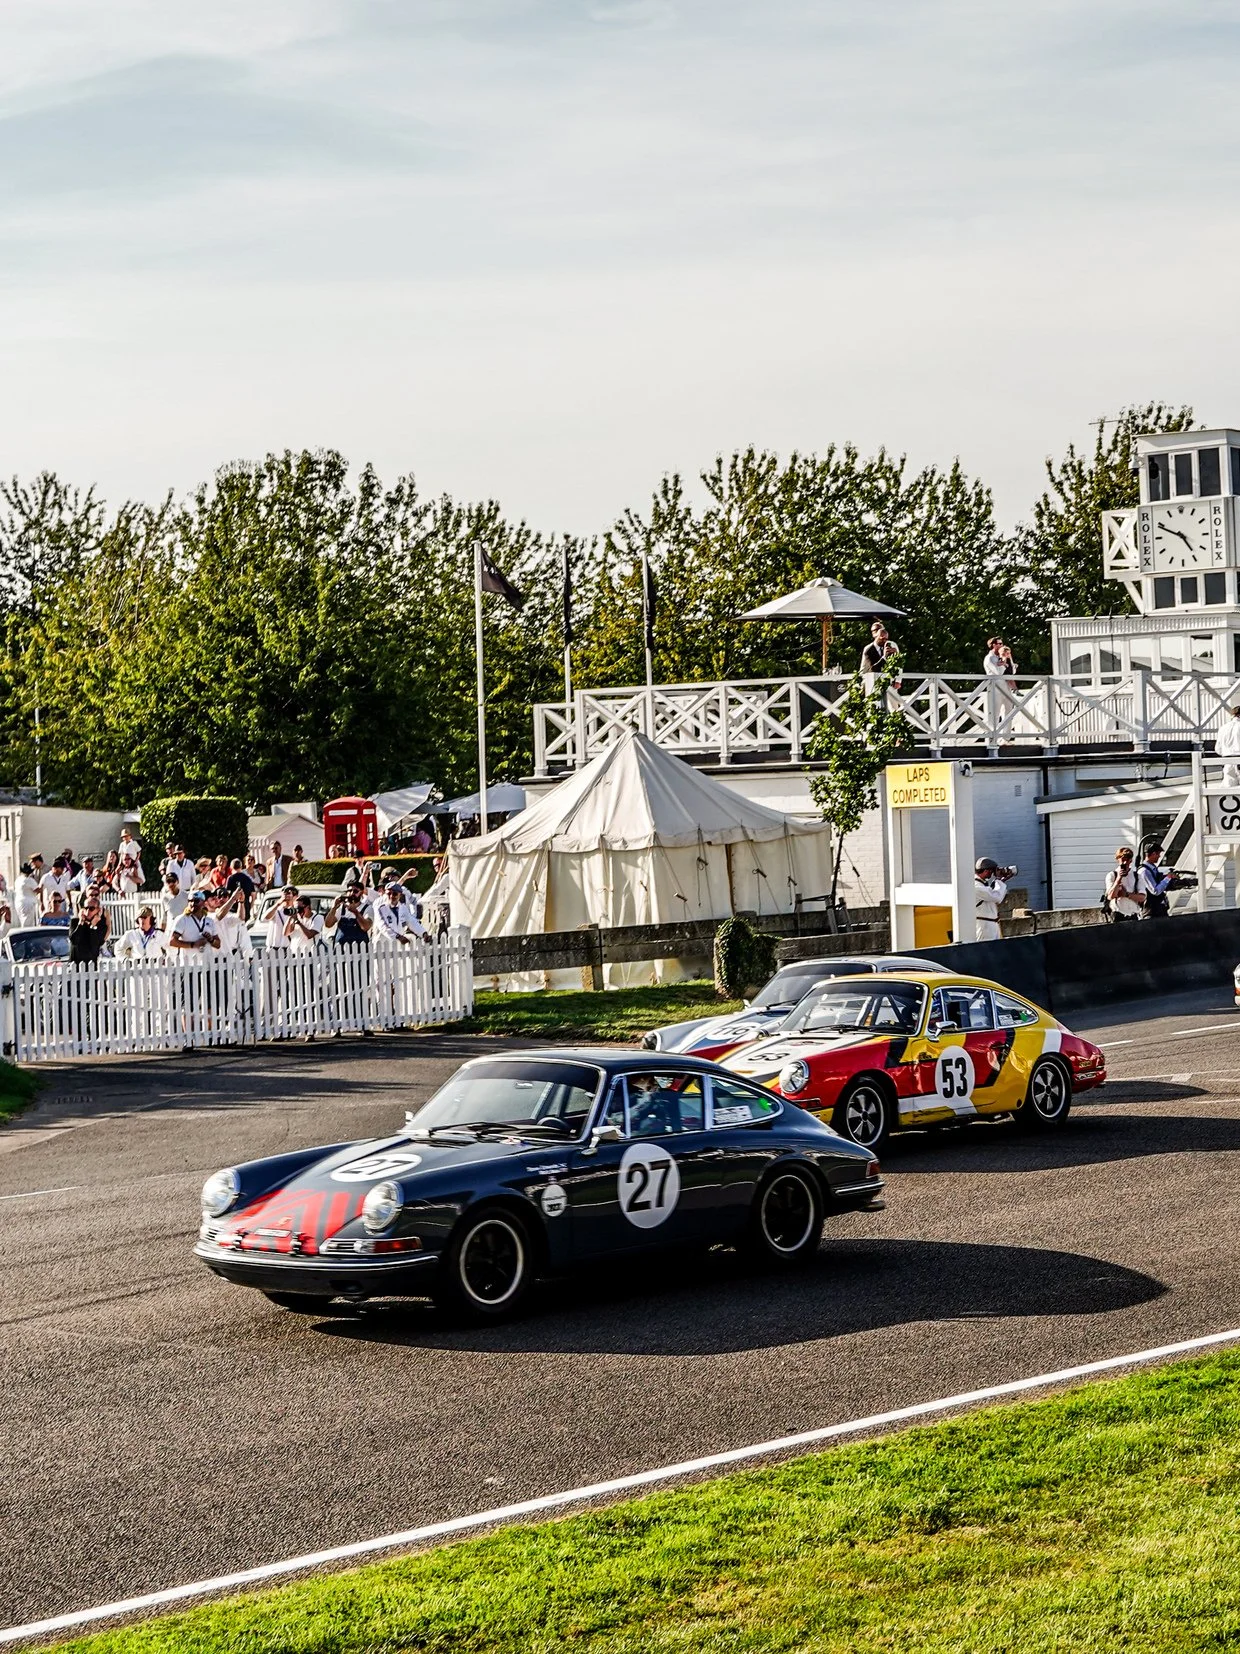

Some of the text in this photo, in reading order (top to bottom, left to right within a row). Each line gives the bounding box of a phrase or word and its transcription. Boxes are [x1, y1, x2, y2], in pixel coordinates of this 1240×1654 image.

[1141, 512, 1152, 567] ROLEX
[1213, 506, 1224, 561] ROLEX
[906, 767, 930, 782] LAPS
[892, 787, 946, 804] COMPLETED
[747, 1052, 791, 1061] 53
[941, 1057, 968, 1099] 53
[345, 1158, 414, 1176] 27
[626, 1159, 671, 1212] 27
